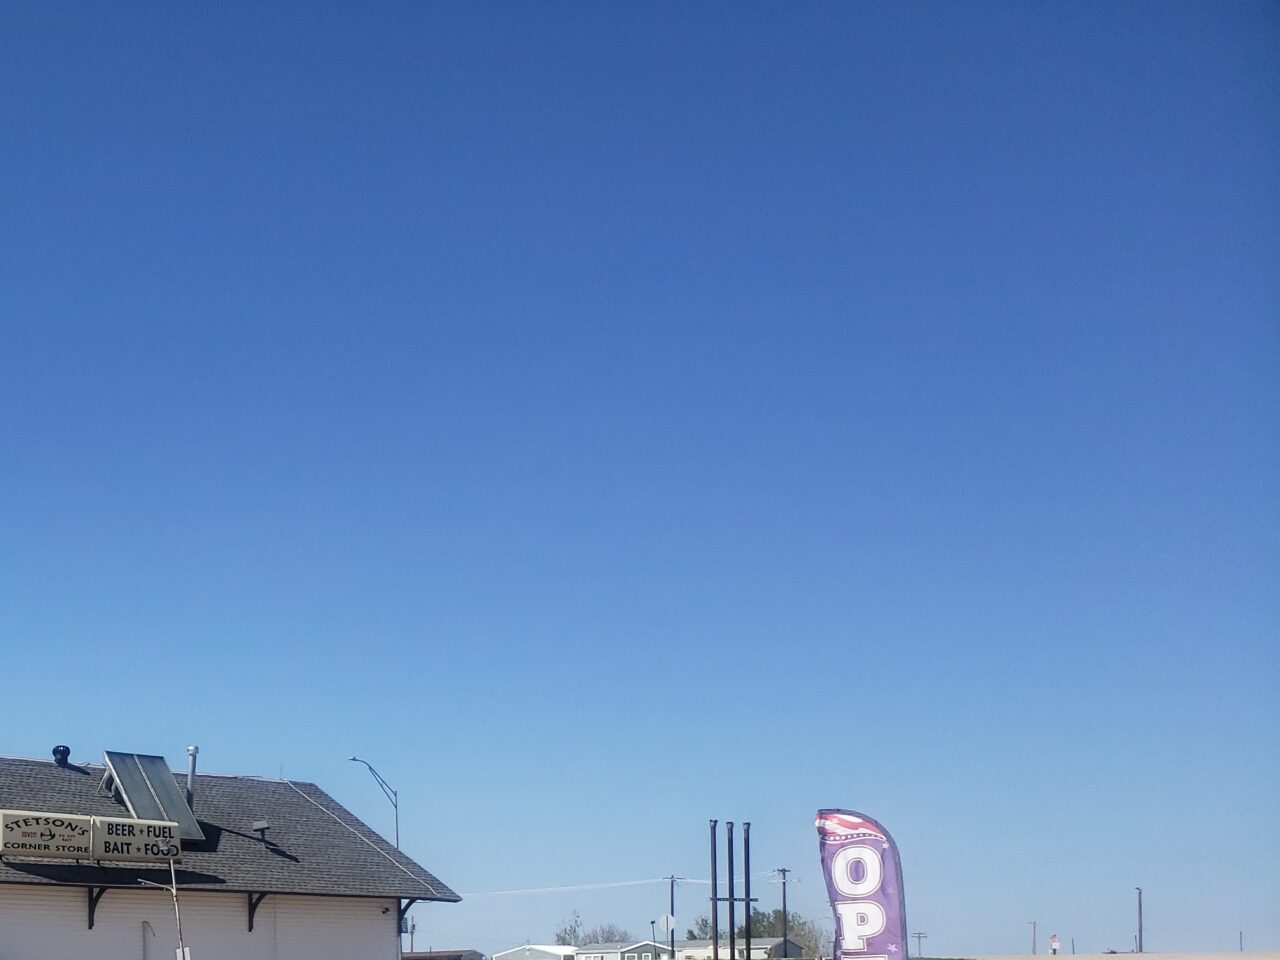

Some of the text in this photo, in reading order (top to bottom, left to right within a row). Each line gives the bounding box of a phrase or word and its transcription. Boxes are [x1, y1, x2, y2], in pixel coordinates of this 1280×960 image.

[4, 817, 89, 836] STETSON'S
[107, 823, 175, 839] BEER FUEL
[3, 842, 90, 854] CORNER STORE
[103, 840, 179, 857] BAIT FOOD
